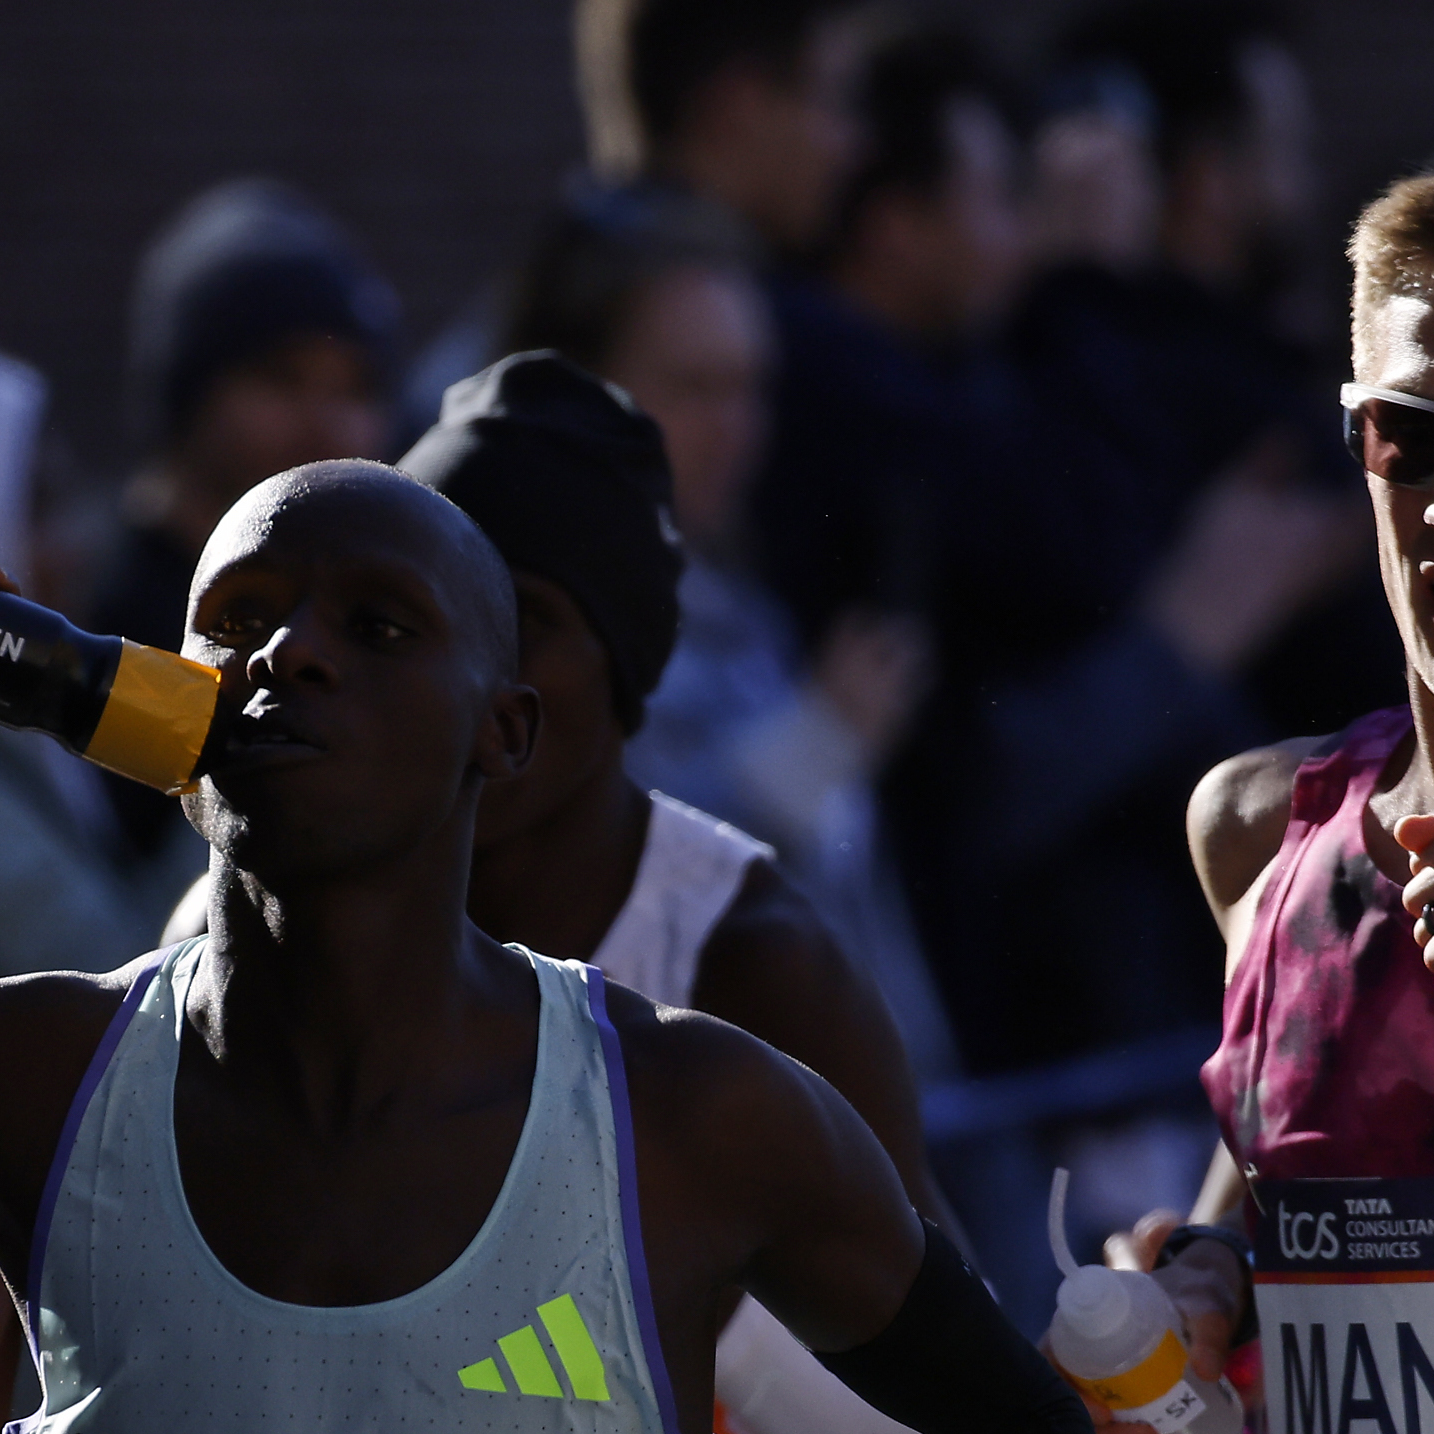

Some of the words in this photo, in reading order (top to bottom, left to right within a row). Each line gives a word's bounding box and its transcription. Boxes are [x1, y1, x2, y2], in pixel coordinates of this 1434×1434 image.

[1344, 1199, 1393, 1215] TATA
[1278, 1200, 1339, 1260] tcs
[1347, 1241, 1421, 1259] SERVICES
